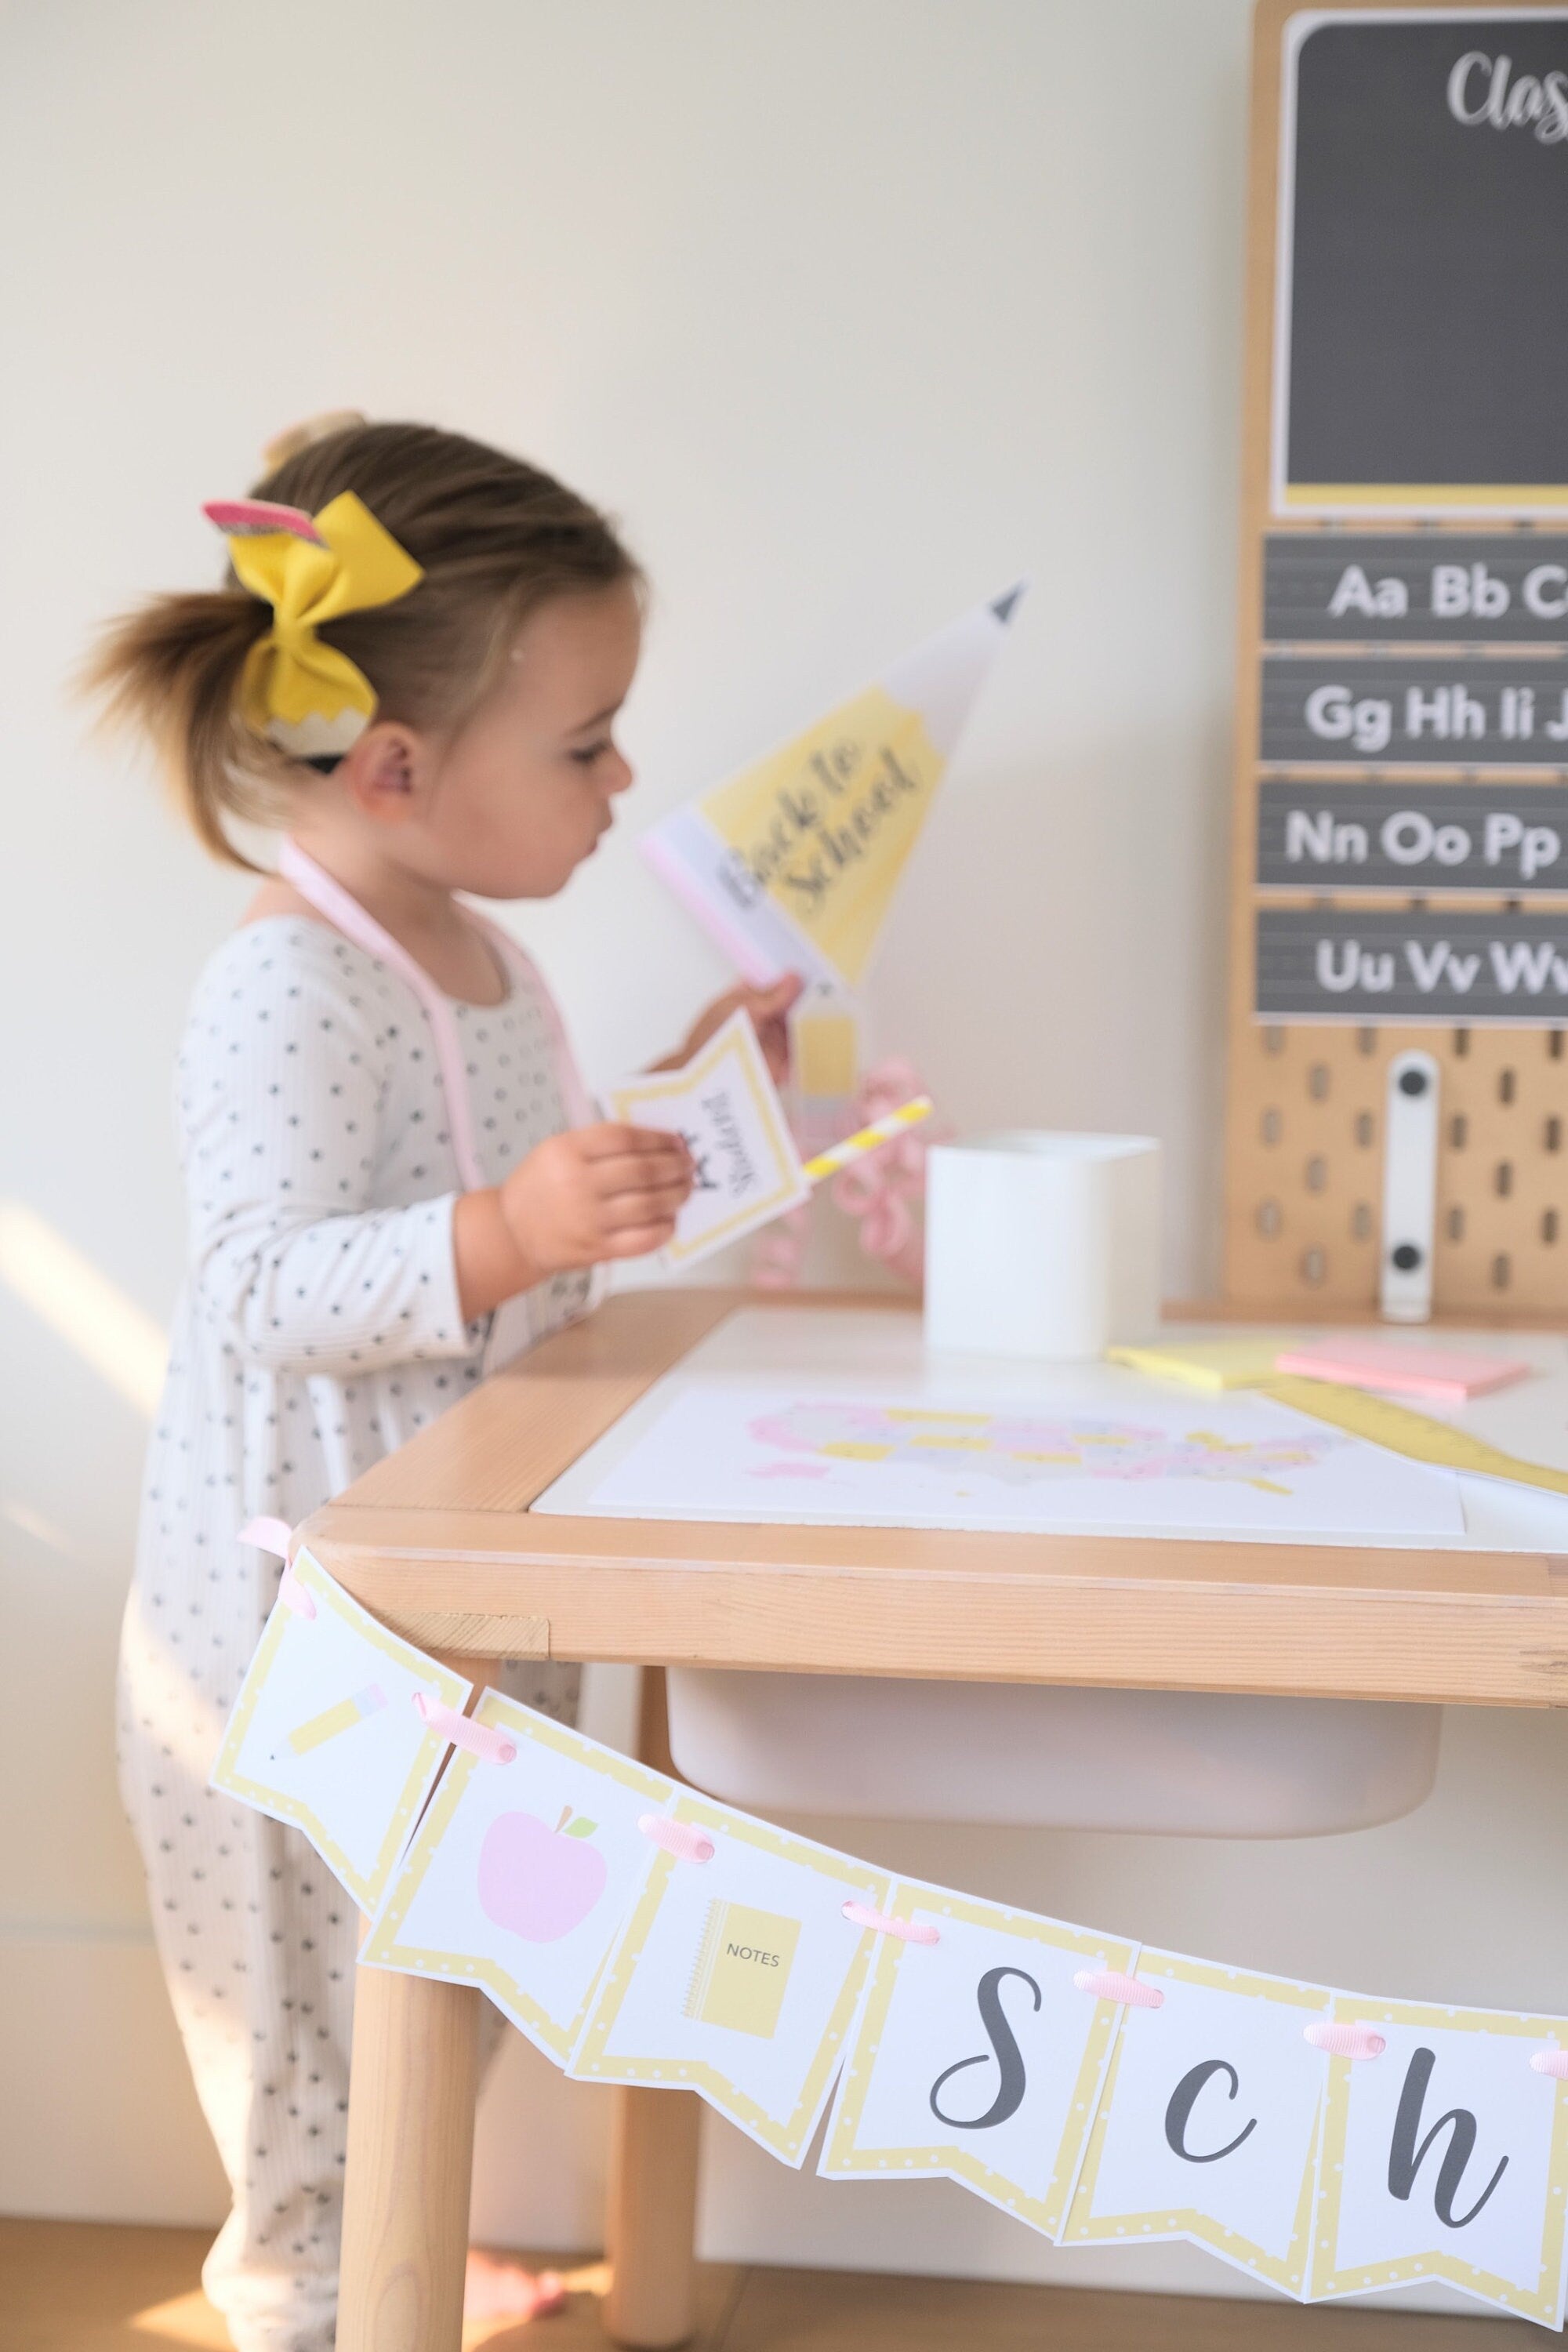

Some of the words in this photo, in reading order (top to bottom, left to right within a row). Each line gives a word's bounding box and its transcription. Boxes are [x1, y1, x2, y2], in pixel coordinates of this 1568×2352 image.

[1328, 564, 1409, 619] Aa
[1432, 562, 1510, 619] Bb
[1523, 564, 1568, 619] C
[1305, 684, 1393, 753] Gg
[1406, 684, 1486, 739] Hh
[784, 743, 919, 924] School
[1286, 809, 1369, 862] Nn
[1381, 810, 1472, 866] Oo
[1483, 812, 1560, 880] Pp
[1316, 939, 1395, 993] Uu
[1405, 941, 1482, 994] Vv
[726, 1943, 781, 1968] NOTES
